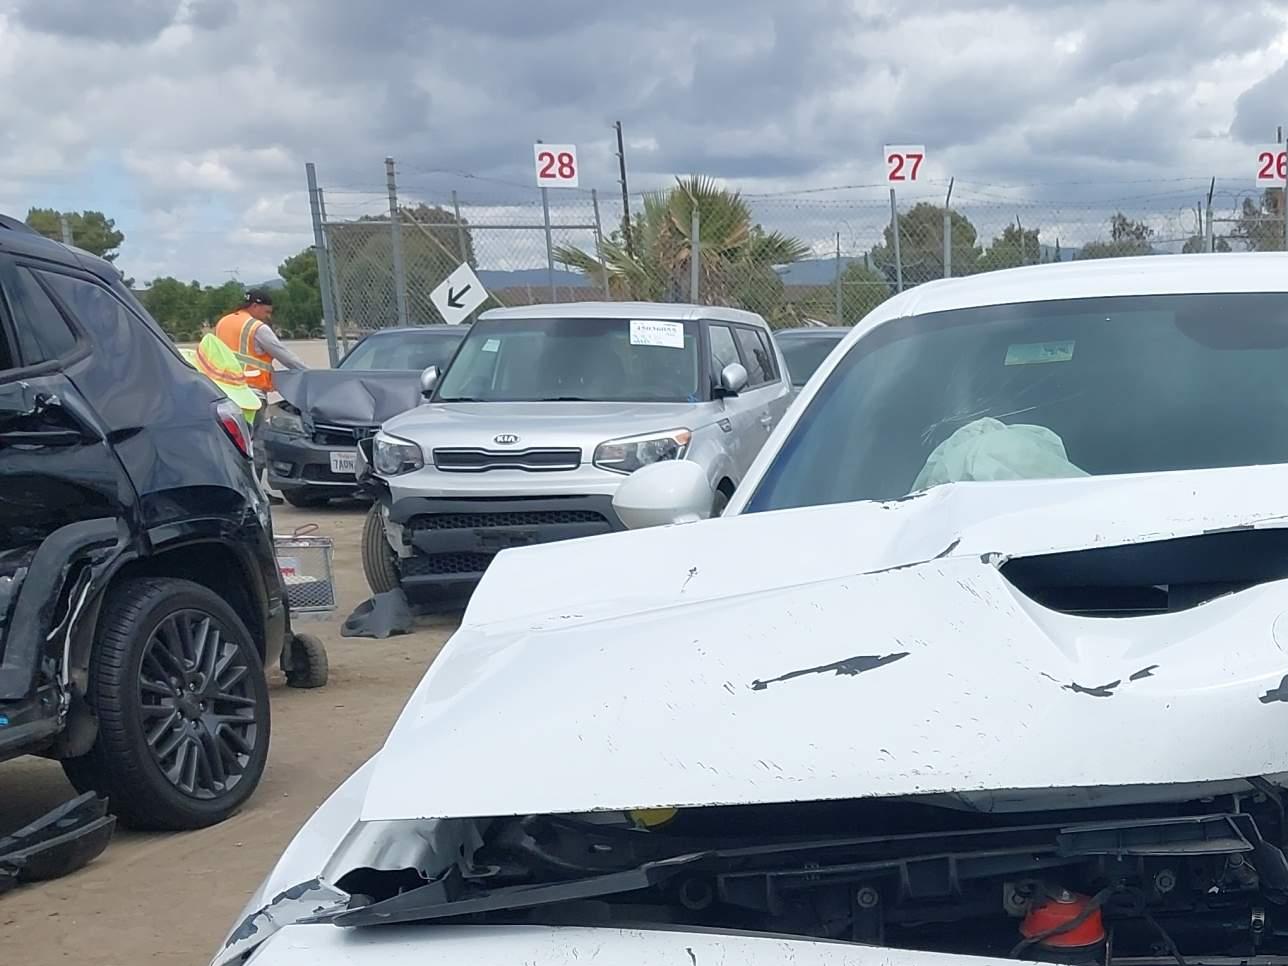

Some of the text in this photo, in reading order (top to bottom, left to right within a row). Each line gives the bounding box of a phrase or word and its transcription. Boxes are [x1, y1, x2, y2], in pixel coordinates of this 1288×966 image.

[538, 151, 575, 179] 28
[887, 153, 923, 181] 27
[1258, 151, 1288, 179] 26
[494, 434, 519, 444] KIA
